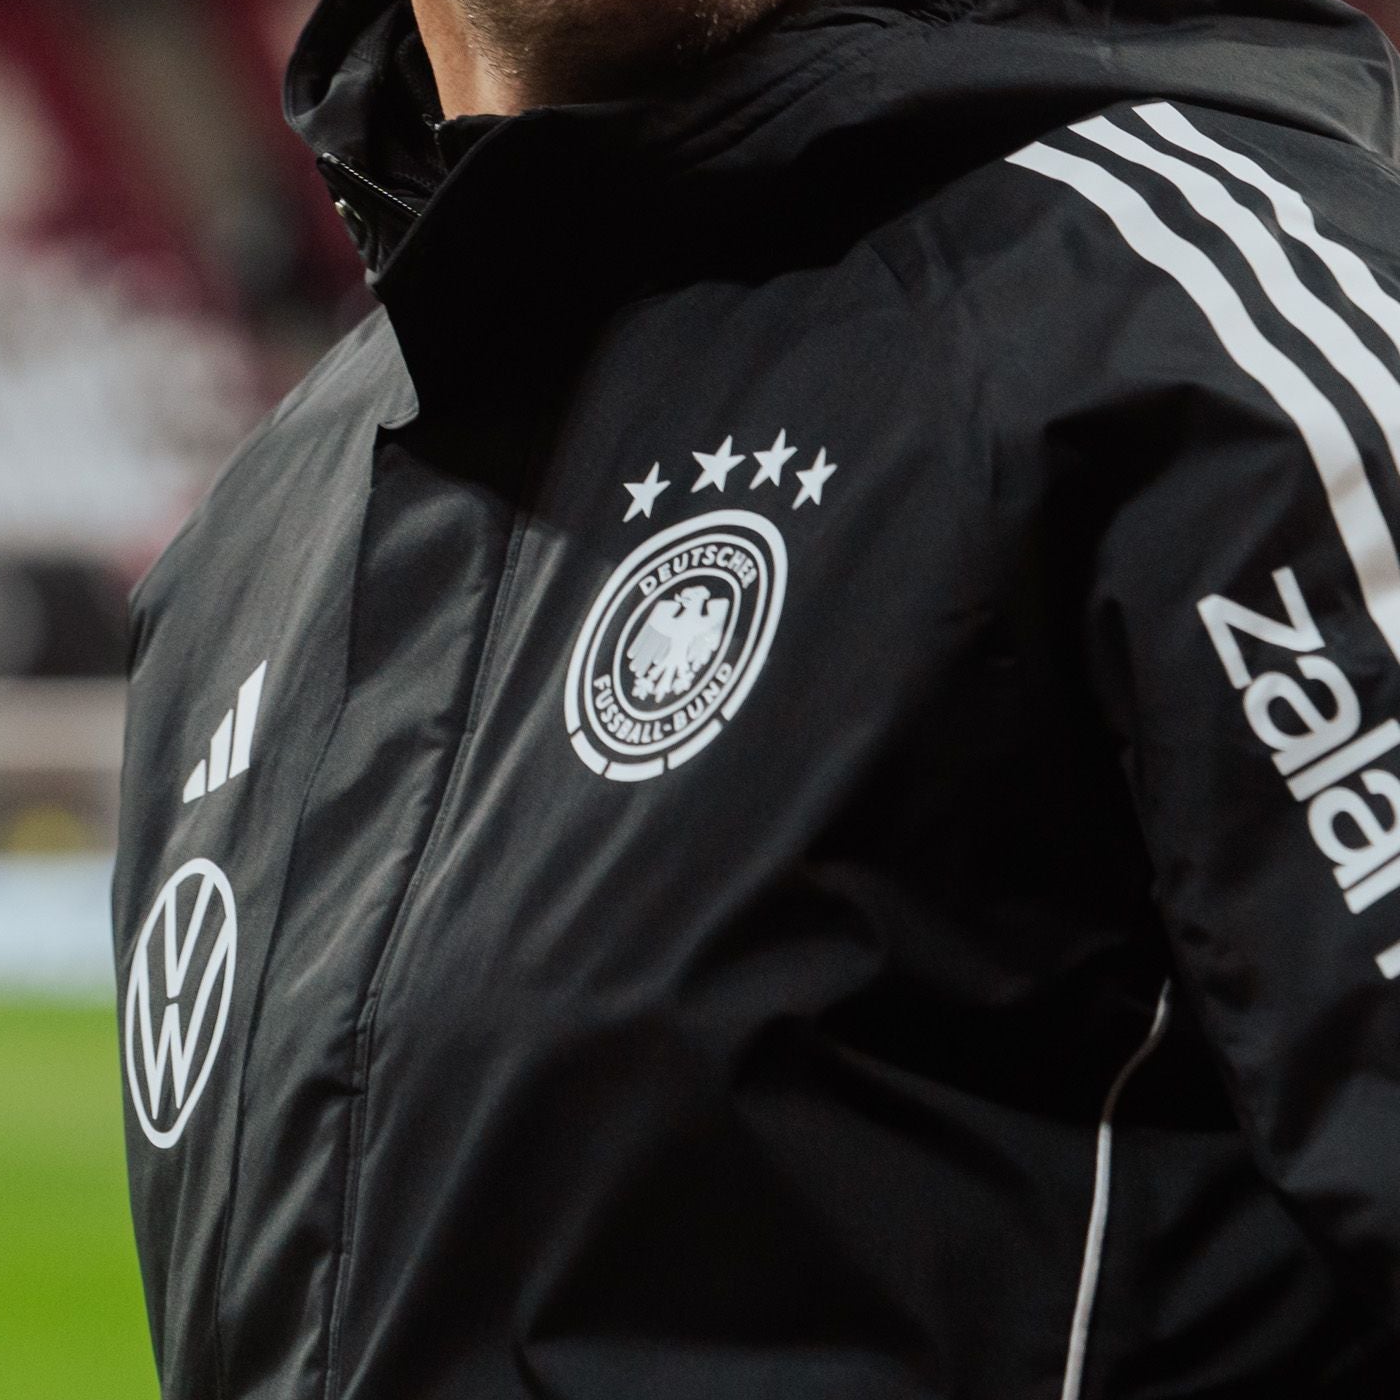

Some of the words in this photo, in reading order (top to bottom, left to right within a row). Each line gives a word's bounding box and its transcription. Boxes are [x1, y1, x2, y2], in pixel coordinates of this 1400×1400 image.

[638, 544, 757, 596] DEUTSCHER
[593, 664, 734, 744] FUSSBALL-BUND
[134, 868, 234, 1122] VW
